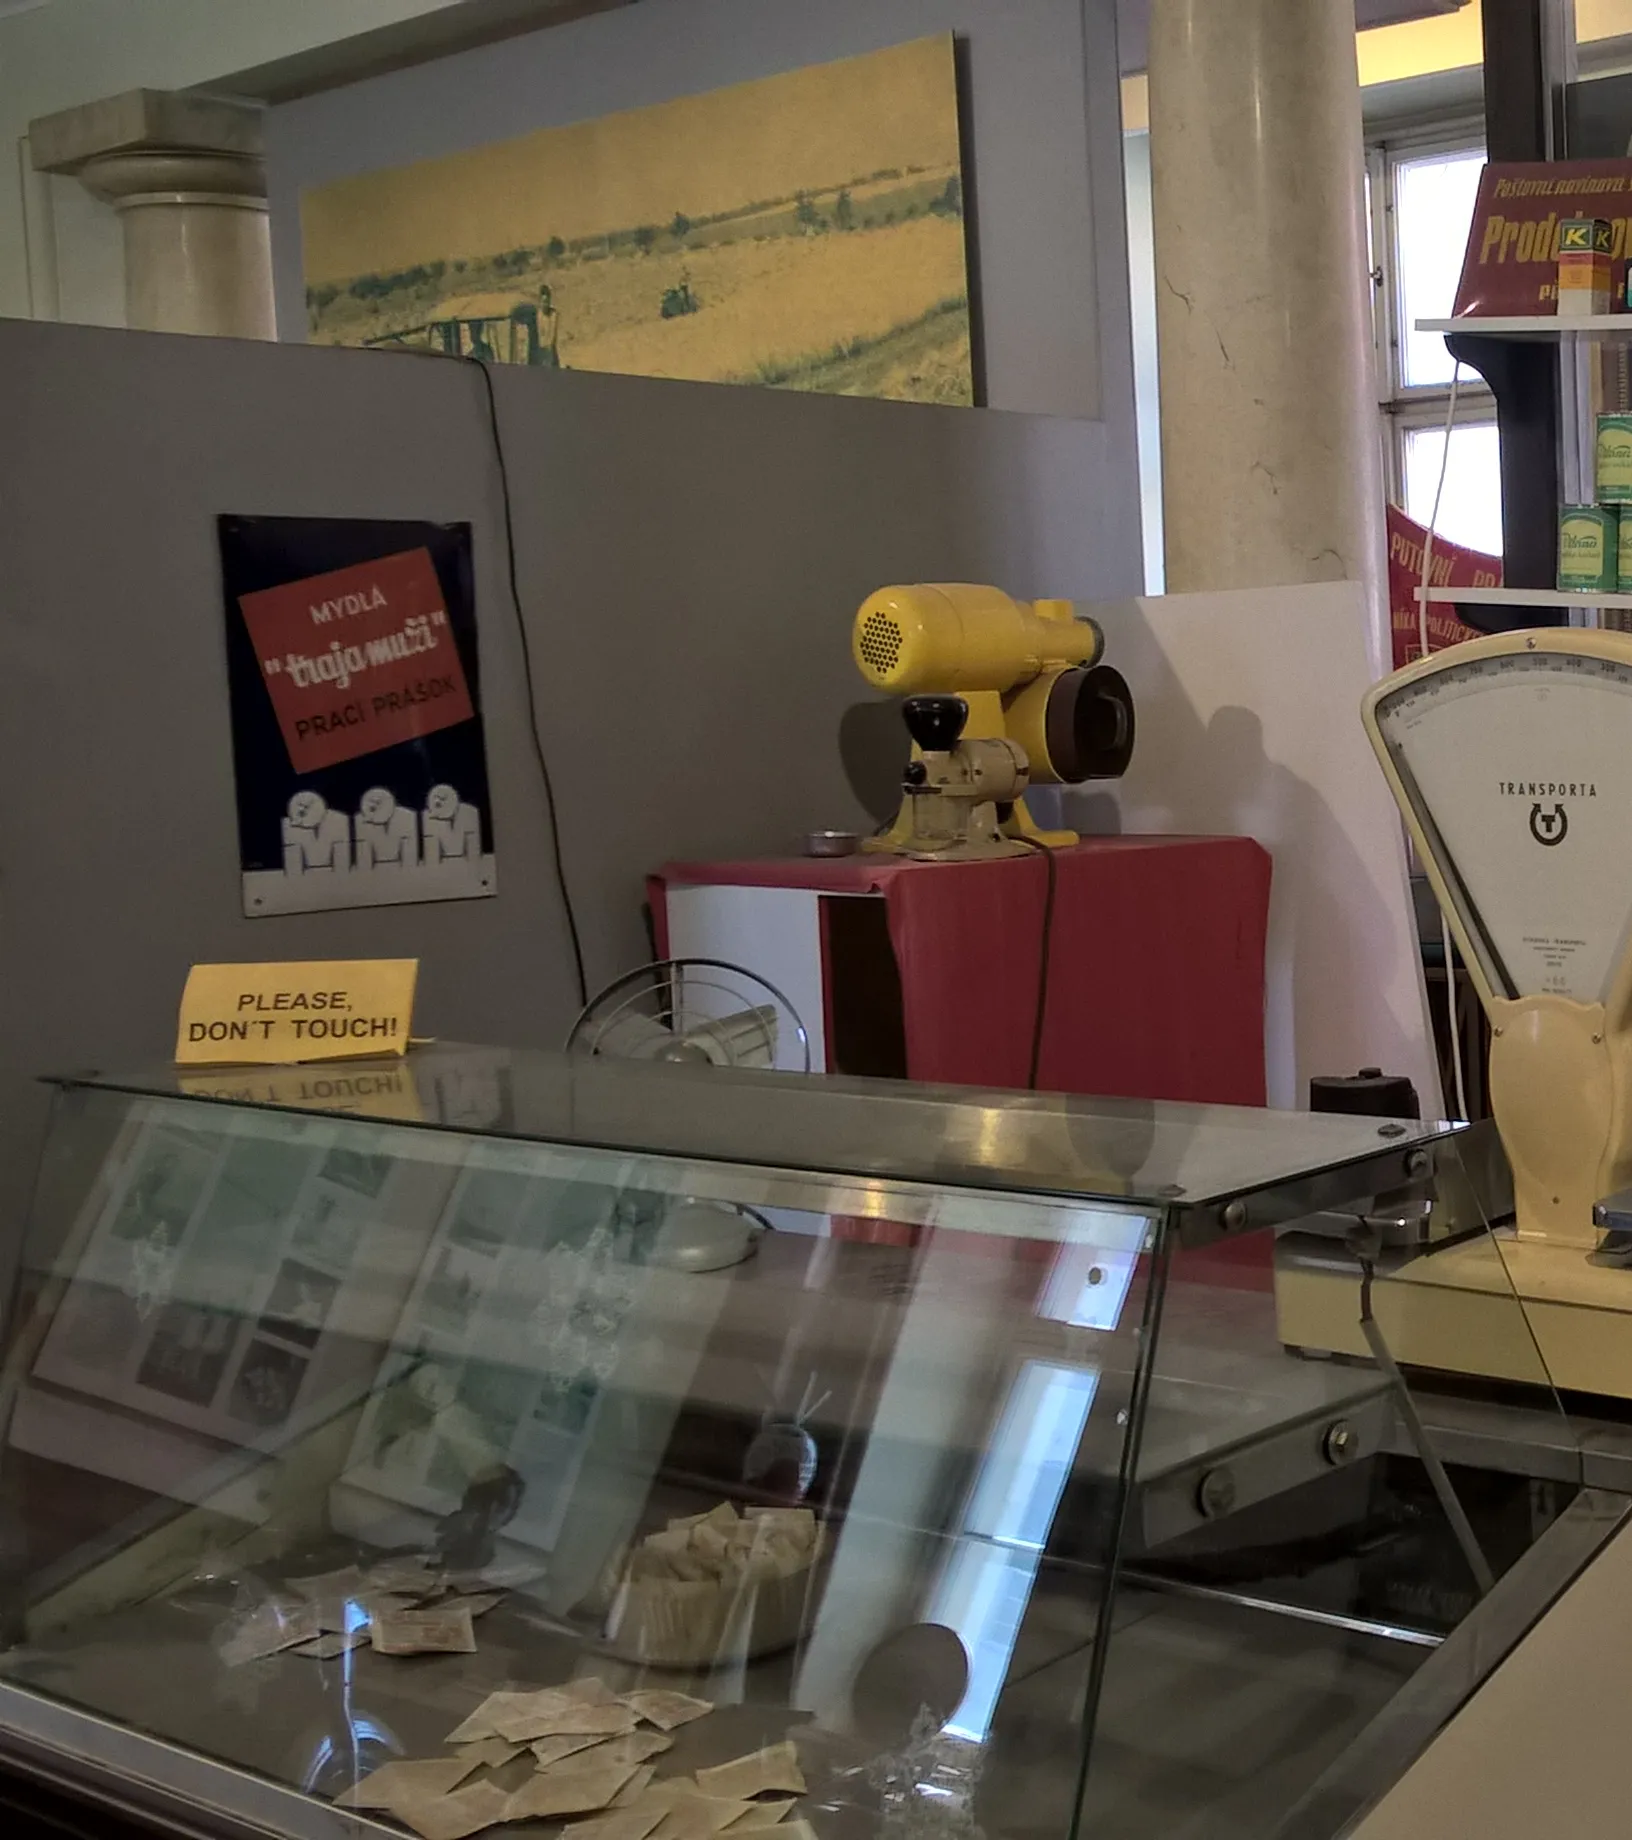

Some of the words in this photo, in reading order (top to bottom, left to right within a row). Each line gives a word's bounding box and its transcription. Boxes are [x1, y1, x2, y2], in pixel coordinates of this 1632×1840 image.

[1564, 228, 1588, 246] K
[1498, 781, 1597, 798] TRANSPORTA
[237, 992, 353, 1012] PLEASE,
[292, 1016, 397, 1039] TOUCH!
